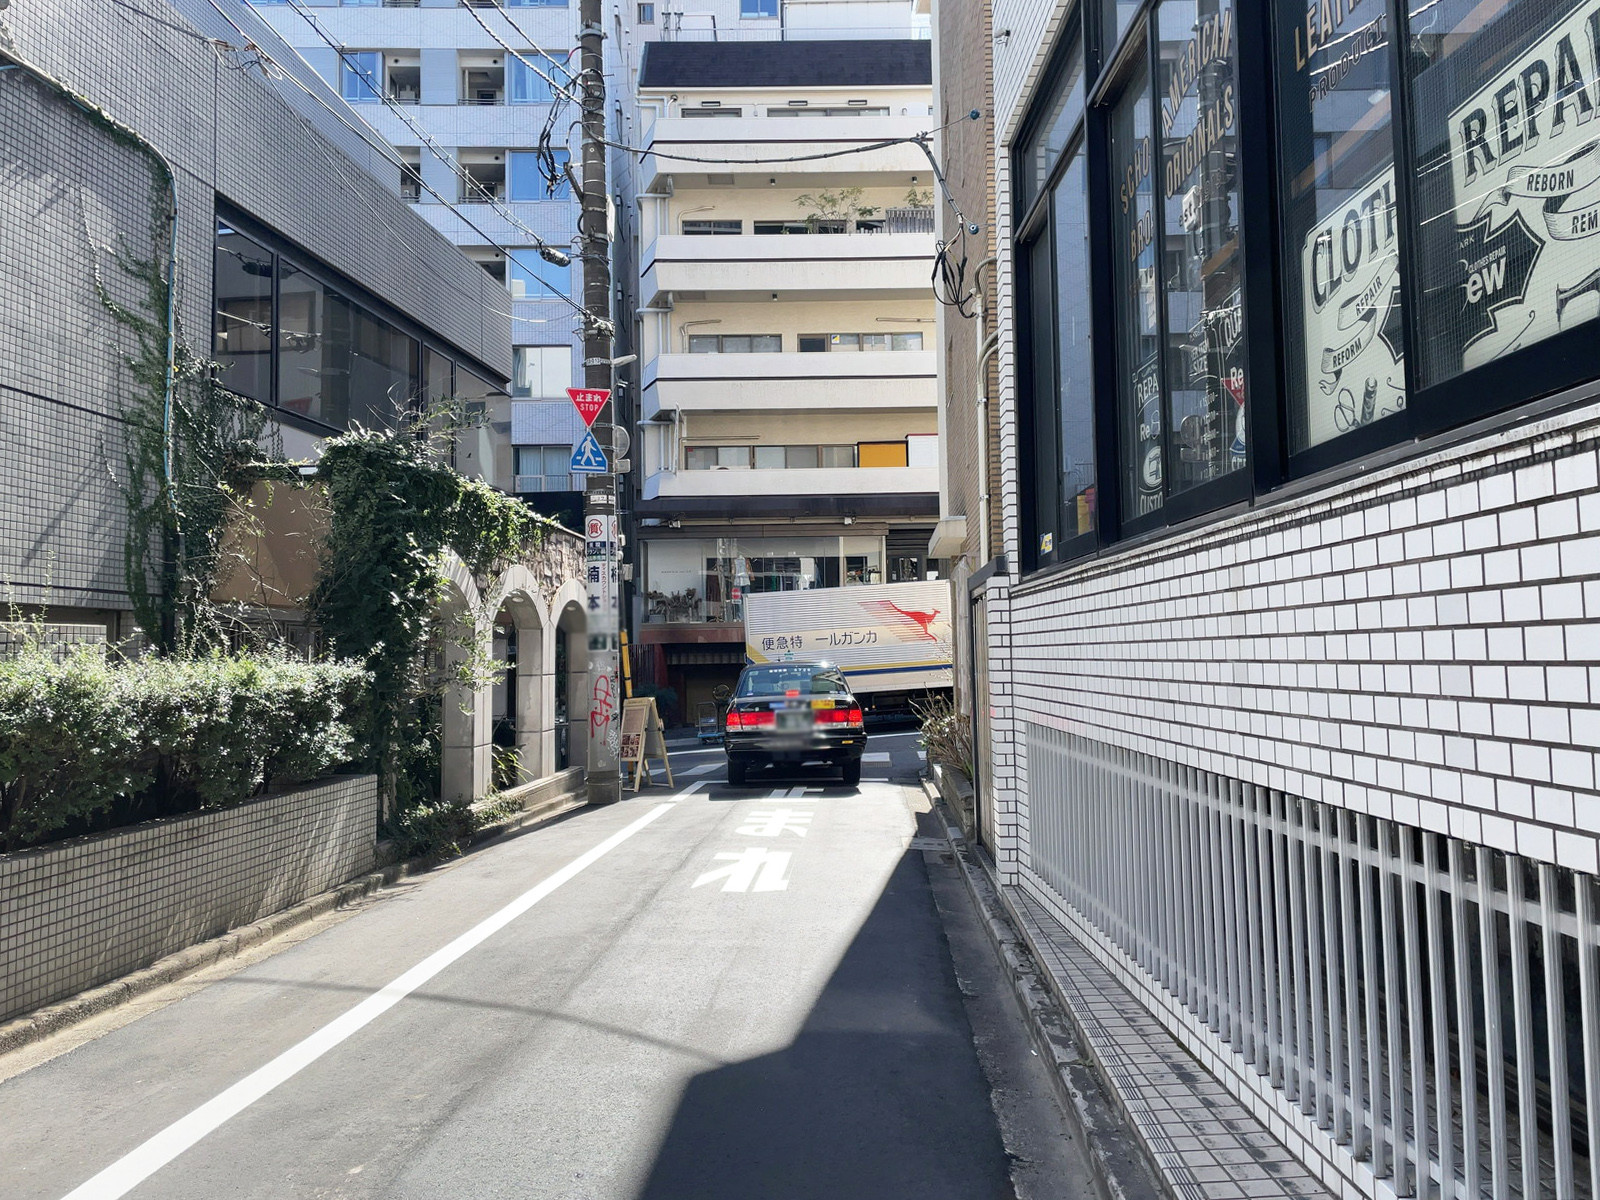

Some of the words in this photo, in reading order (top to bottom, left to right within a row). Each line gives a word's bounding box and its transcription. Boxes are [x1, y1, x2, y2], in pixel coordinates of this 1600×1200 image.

[1294, 0, 1361, 72] LEA
[1161, 8, 1232, 139] AMERICAN
[1165, 84, 1234, 200] ORIGINALS
[1526, 169, 1574, 192] REBORN
[1130, 210, 1154, 262] BRO
[1571, 209, 1598, 234] REM
[1355, 275, 1383, 316] REPAIR
[1332, 337, 1363, 369] REFORM
[576, 392, 602, 402] 止まれ
[580, 403, 599, 411] STOP
